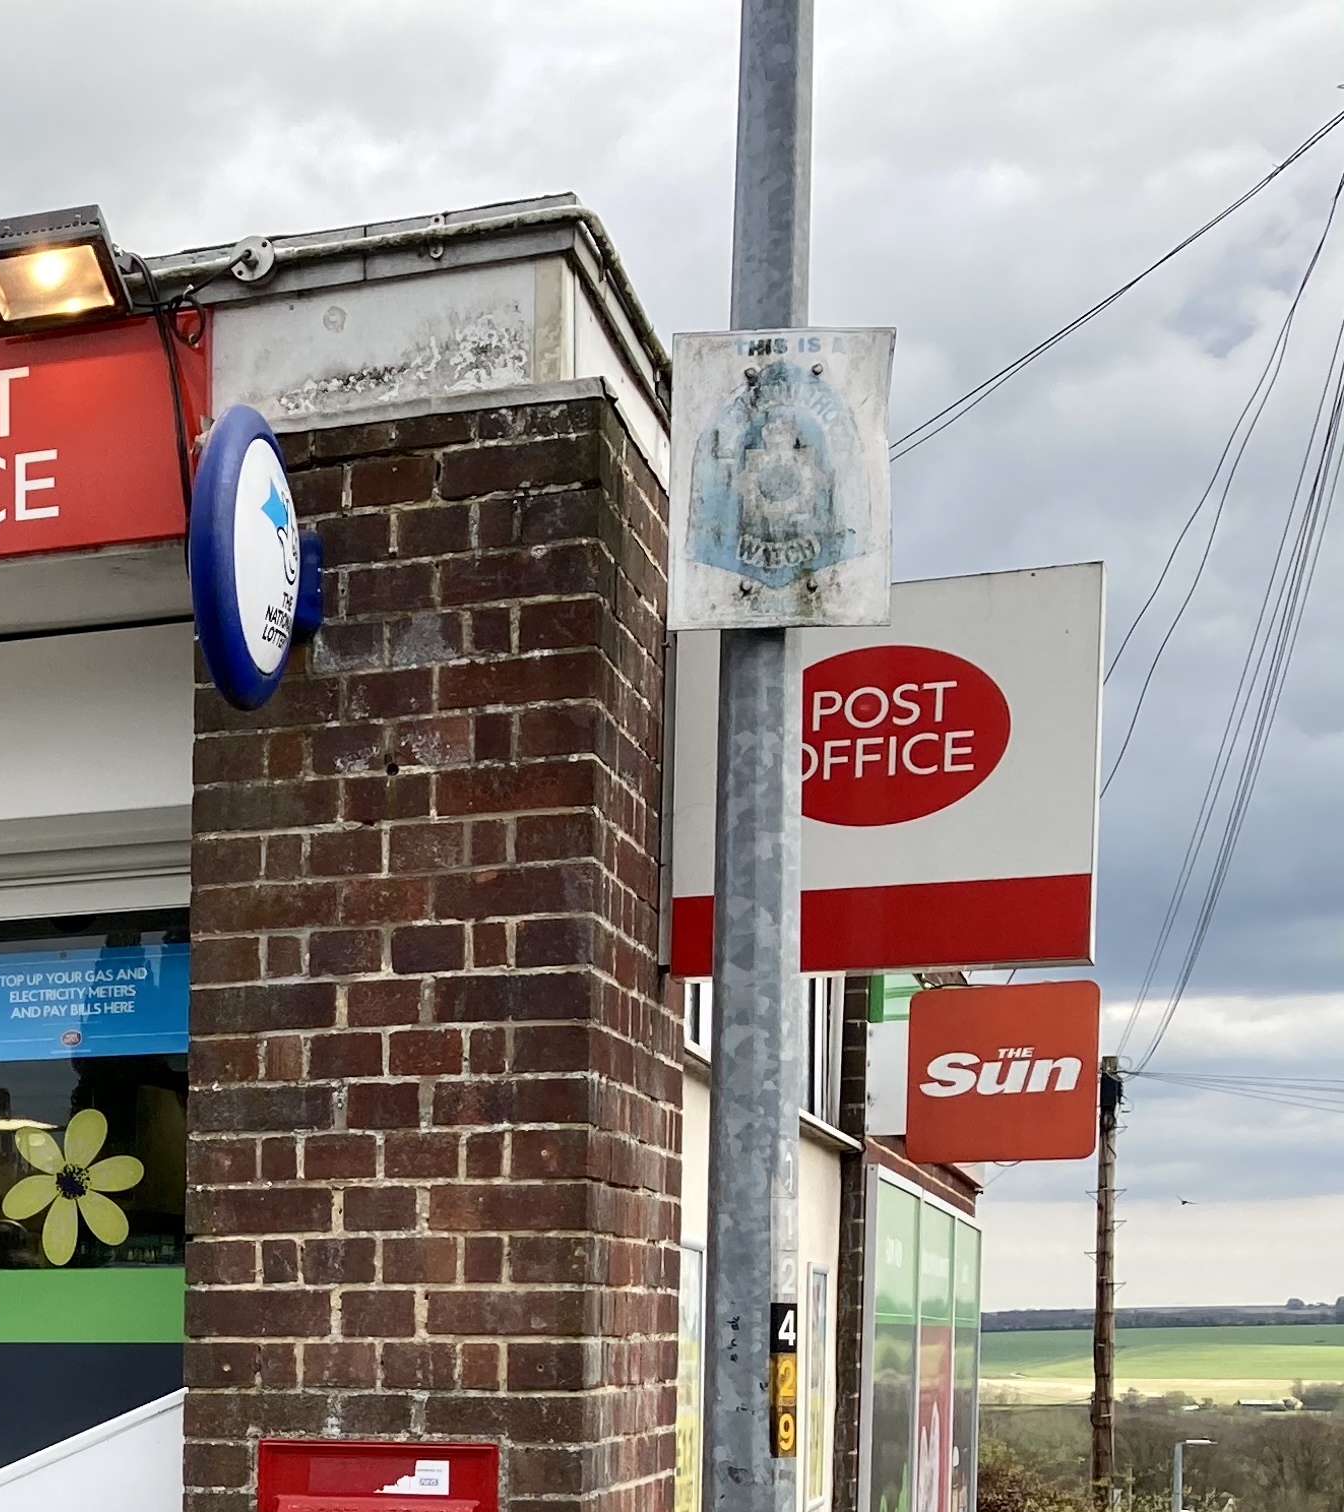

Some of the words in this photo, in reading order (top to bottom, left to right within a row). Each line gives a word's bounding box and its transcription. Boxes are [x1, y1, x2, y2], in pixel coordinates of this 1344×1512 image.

[734, 338, 787, 356] THIS
[798, 337, 821, 354] IS
[736, 533, 821, 568] WATCH
[812, 680, 958, 732] POST
[0, 974, 25, 987] TOP
[26, 973, 43, 986] UP
[46, 972, 82, 985] YOUR
[84, 969, 113, 982] GAS
[116, 967, 147, 981] AND
[9, 987, 86, 1003] ELECTRICITY
[88, 985, 136, 999] METERS
[11, 1006, 41, 1019] AND
[43, 1005, 68, 1017] PAY
[70, 1003, 102, 1016] BILLS
[104, 1001, 135, 1013] HERE
[998, 1046, 1035, 1059] THE
[919, 1052, 1082, 1098] Sun
[778, 1310, 796, 1346] 4
[779, 1360, 795, 1396] 2
[778, 1413, 795, 1451] 9
